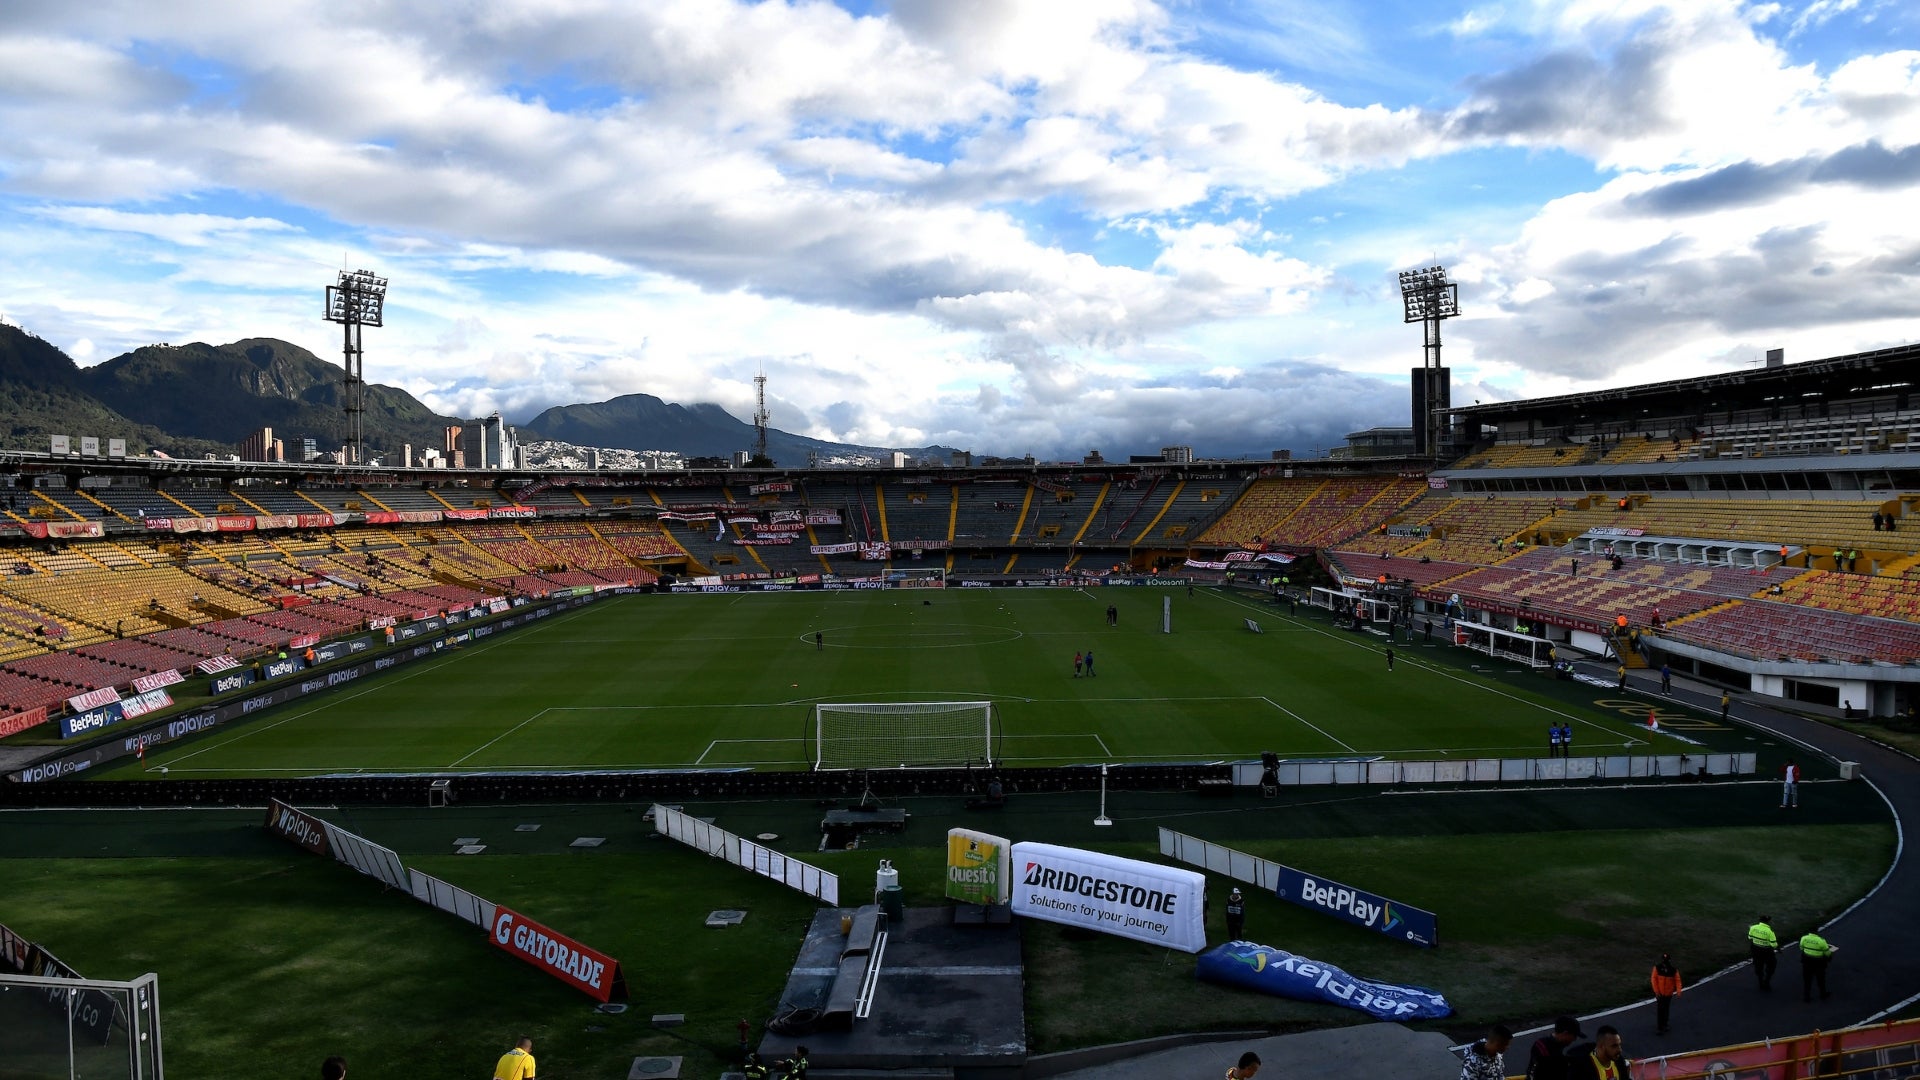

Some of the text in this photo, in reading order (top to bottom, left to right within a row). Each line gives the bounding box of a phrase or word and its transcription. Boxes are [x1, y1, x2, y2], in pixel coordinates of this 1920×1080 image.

[770, 523, 805, 531] QUINTAS
[907, 580, 929, 588] SIKA
[1151, 578, 1184, 586] Ovosanti
[269, 661, 293, 677] BetPlay
[327, 668, 358, 686] Wplay.co
[217, 675, 242, 692] BetPlay
[90, 688, 118, 706] BANDA
[242, 696, 273, 712] Wplay.co
[69, 711, 104, 733] BetPlay
[168, 714, 216, 738] Wplay.co
[125, 732, 161, 751] Wplay.co
[22, 759, 75, 783] Wplay.co
[279, 808, 320, 846] Wplay.co
[950, 865, 996, 884] Quesito
[1023, 862, 1177, 915] BRIDGESTONE
[1302, 878, 1381, 927] BetPlay
[1030, 894, 1168, 936] Solutions for your journey
[496, 913, 605, 989] G GATORADE
